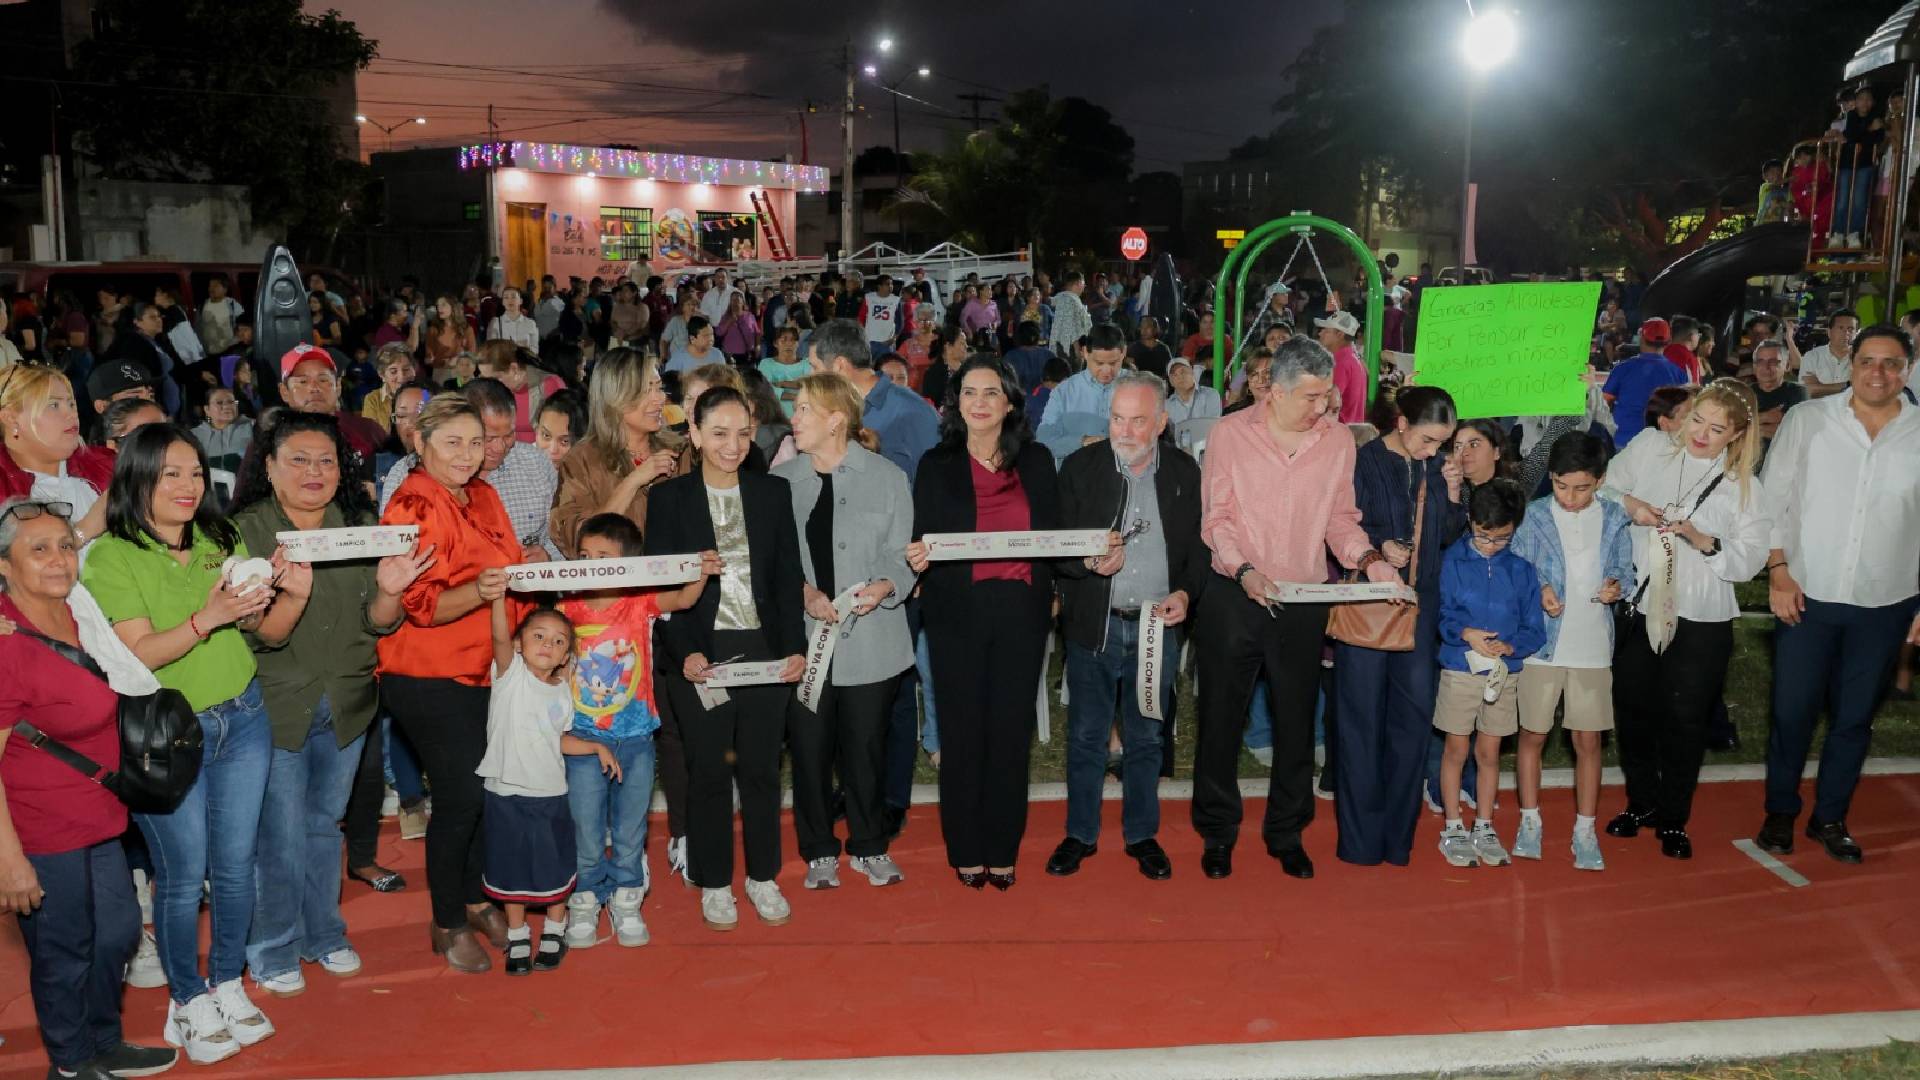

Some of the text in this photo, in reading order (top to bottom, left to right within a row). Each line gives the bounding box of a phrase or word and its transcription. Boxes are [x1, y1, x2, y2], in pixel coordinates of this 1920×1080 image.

[1123, 238, 1145, 250] ALTO
[1426, 321, 1567, 353] Por Pensar en
[539, 569, 554, 579] VA
[558, 567, 587, 578] CON
[591, 566, 626, 577] TODO
[816, 628, 830, 650] CON
[812, 653, 823, 664] VA
[1146, 647, 1155, 659] VA
[1145, 661, 1154, 683] CON
[1145, 686, 1154, 712] TODO
